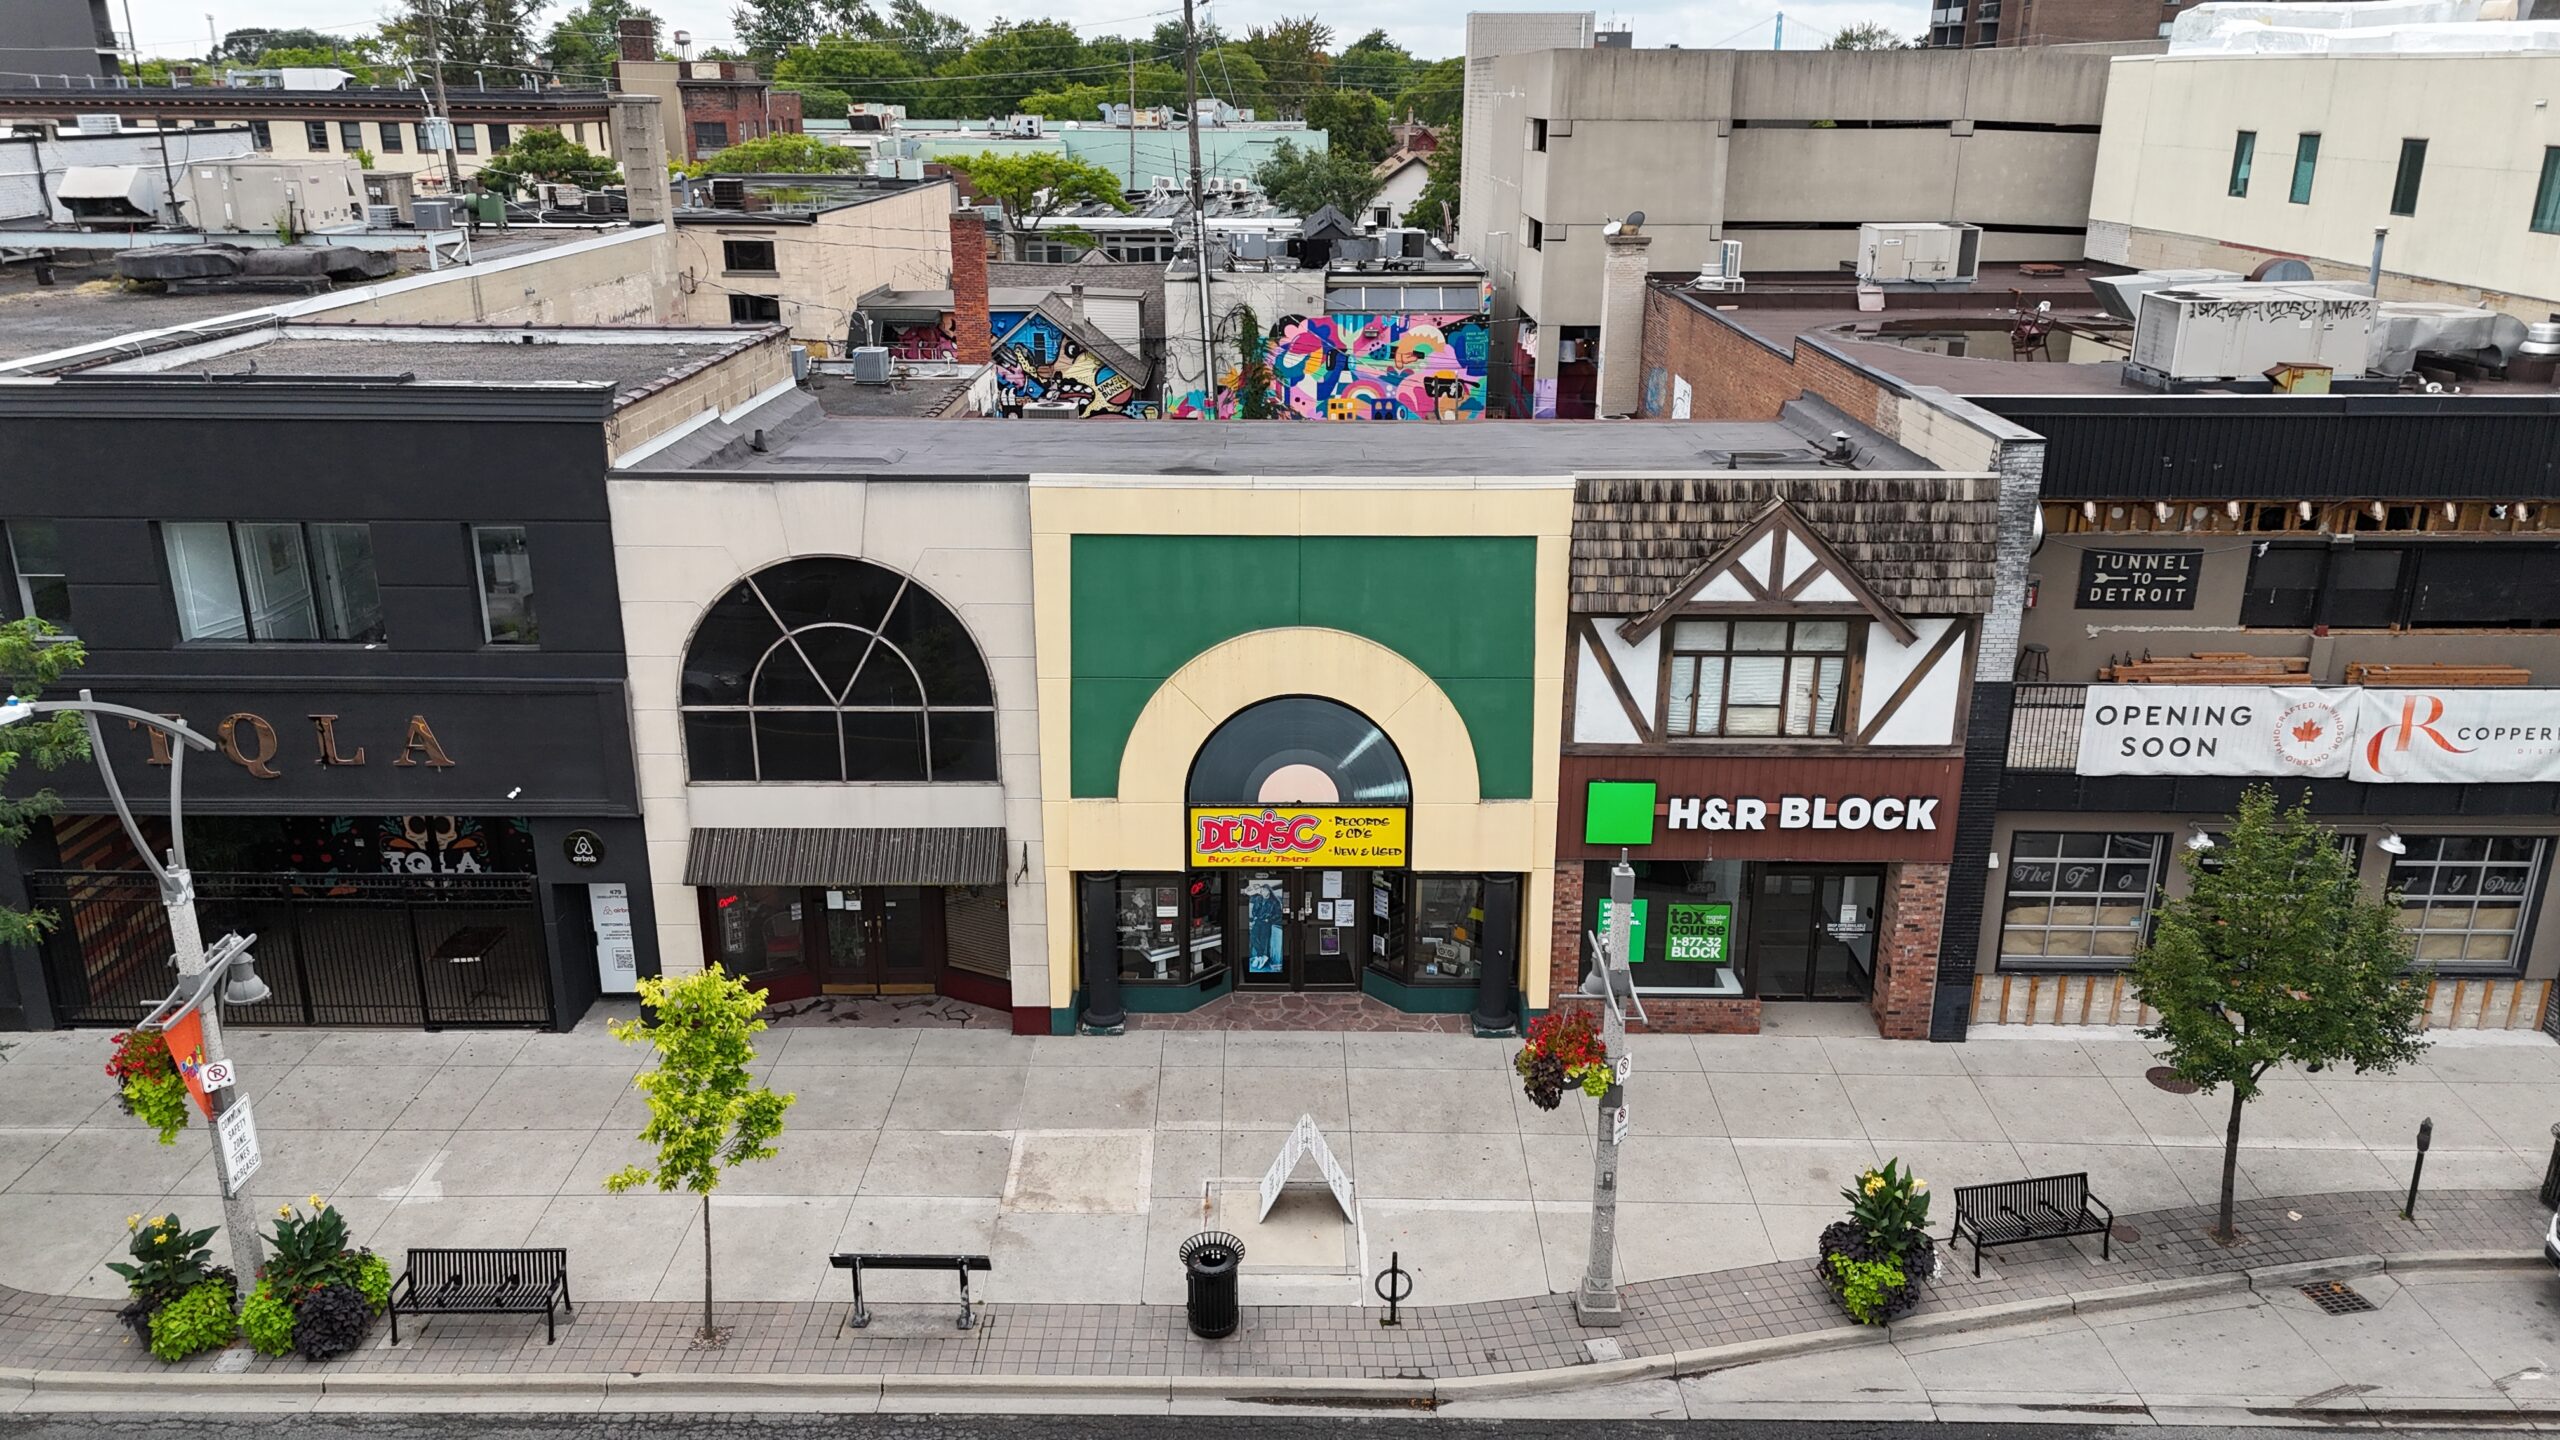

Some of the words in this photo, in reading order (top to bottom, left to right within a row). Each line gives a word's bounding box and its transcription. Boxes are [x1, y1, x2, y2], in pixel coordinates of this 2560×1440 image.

[2096, 555, 2190, 570] TUNNEL
[2132, 572, 2152, 585] TO
[2089, 588, 2186, 602] DETROIT
[2095, 705, 2252, 726] OPENING
[2457, 727, 2560, 741] COPPER
[2121, 736, 2218, 757] SOON
[1668, 798, 1767, 830] H&R
[1779, 797, 1939, 830] BLOCK
[1334, 816, 1390, 827] RECORDS
[1335, 830, 1344, 839] &
[1334, 847, 1358, 857] NEW
[1361, 847, 1371, 857] &
[1374, 846, 1403, 857] USED
[383, 851, 483, 874] TQLA
[573, 855, 597, 863] airbnb
[1207, 855, 1237, 864] BUY,
[1241, 855, 1272, 864] SELL,
[1275, 855, 1312, 863] TRADE
[2013, 864, 2051, 882] The
[1688, 882, 1714, 892] OPEN
[2484, 875, 2526, 893] Pub
[718, 895, 738, 908] Open
[1671, 908, 1706, 925] tax
[1669, 925, 1726, 936] course
[1671, 936, 1721, 946] 1-877-32
[1671, 946, 1721, 959] BLOCK
[221, 1101, 250, 1131] COMMUNITY
[228, 1117, 247, 1140] SAFETY
[233, 1134, 247, 1151] ZONE
[235, 1146, 251, 1167] FINES
[231, 1152, 260, 1186] INCREASED
